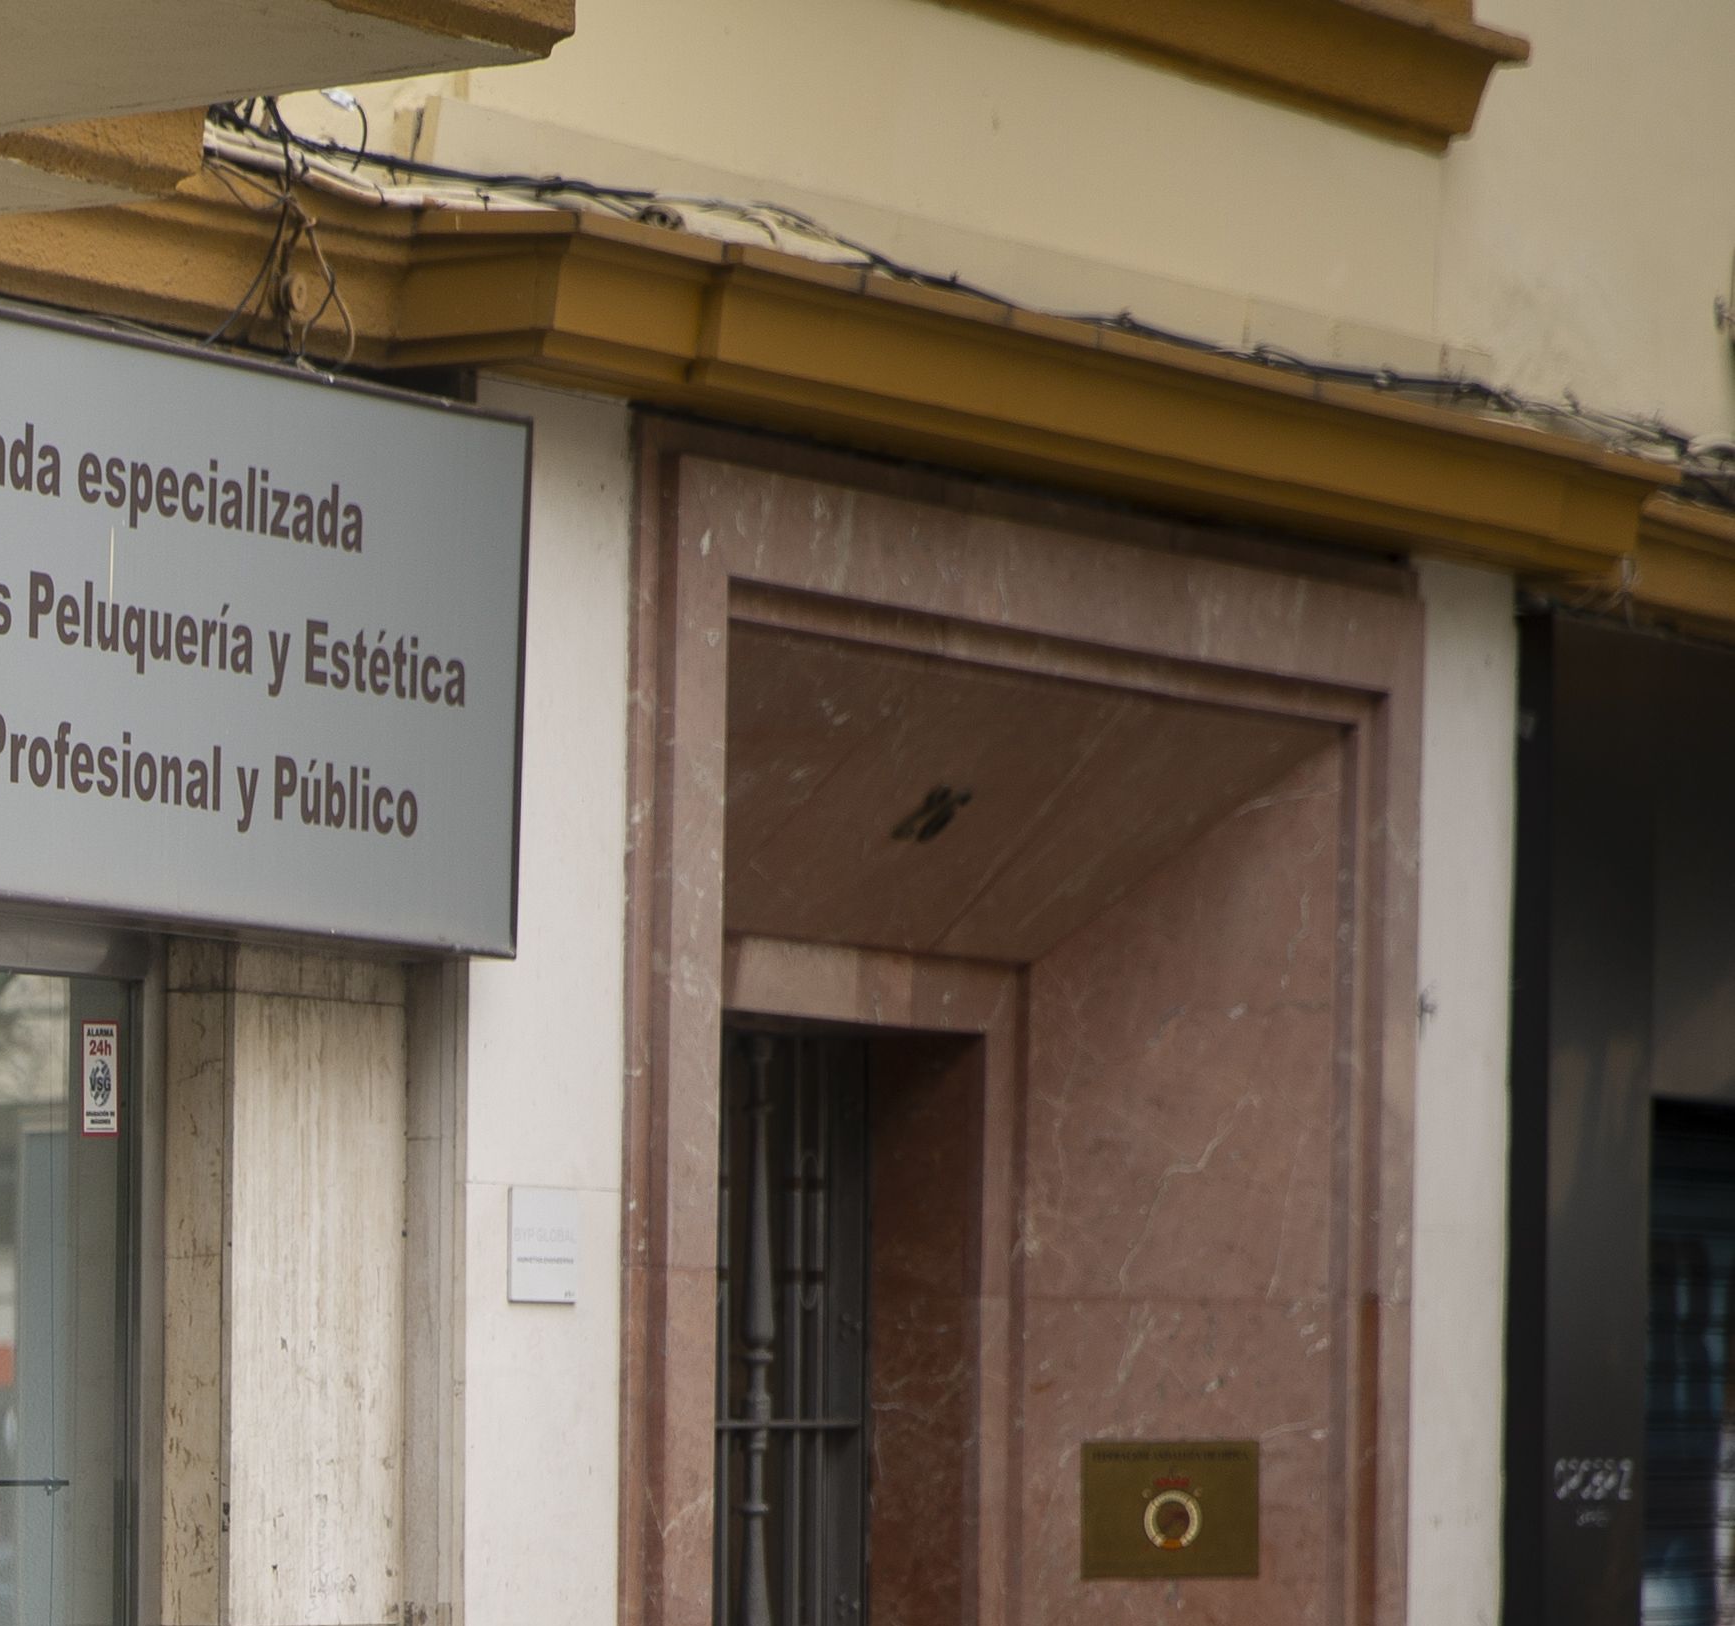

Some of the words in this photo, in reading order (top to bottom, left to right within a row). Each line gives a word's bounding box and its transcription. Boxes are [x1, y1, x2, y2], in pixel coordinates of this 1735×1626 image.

[78, 452, 363, 553] especializada
[29, 571, 253, 675] Peluquería
[268, 630, 291, 697] y
[304, 619, 466, 707] Estética
[237, 765, 258, 833] y
[275, 756, 419, 837] Público
[86, 1027, 114, 1037] ALARMA
[89, 1040, 111, 1056] 24h
[89, 1077, 111, 1091] VSG
